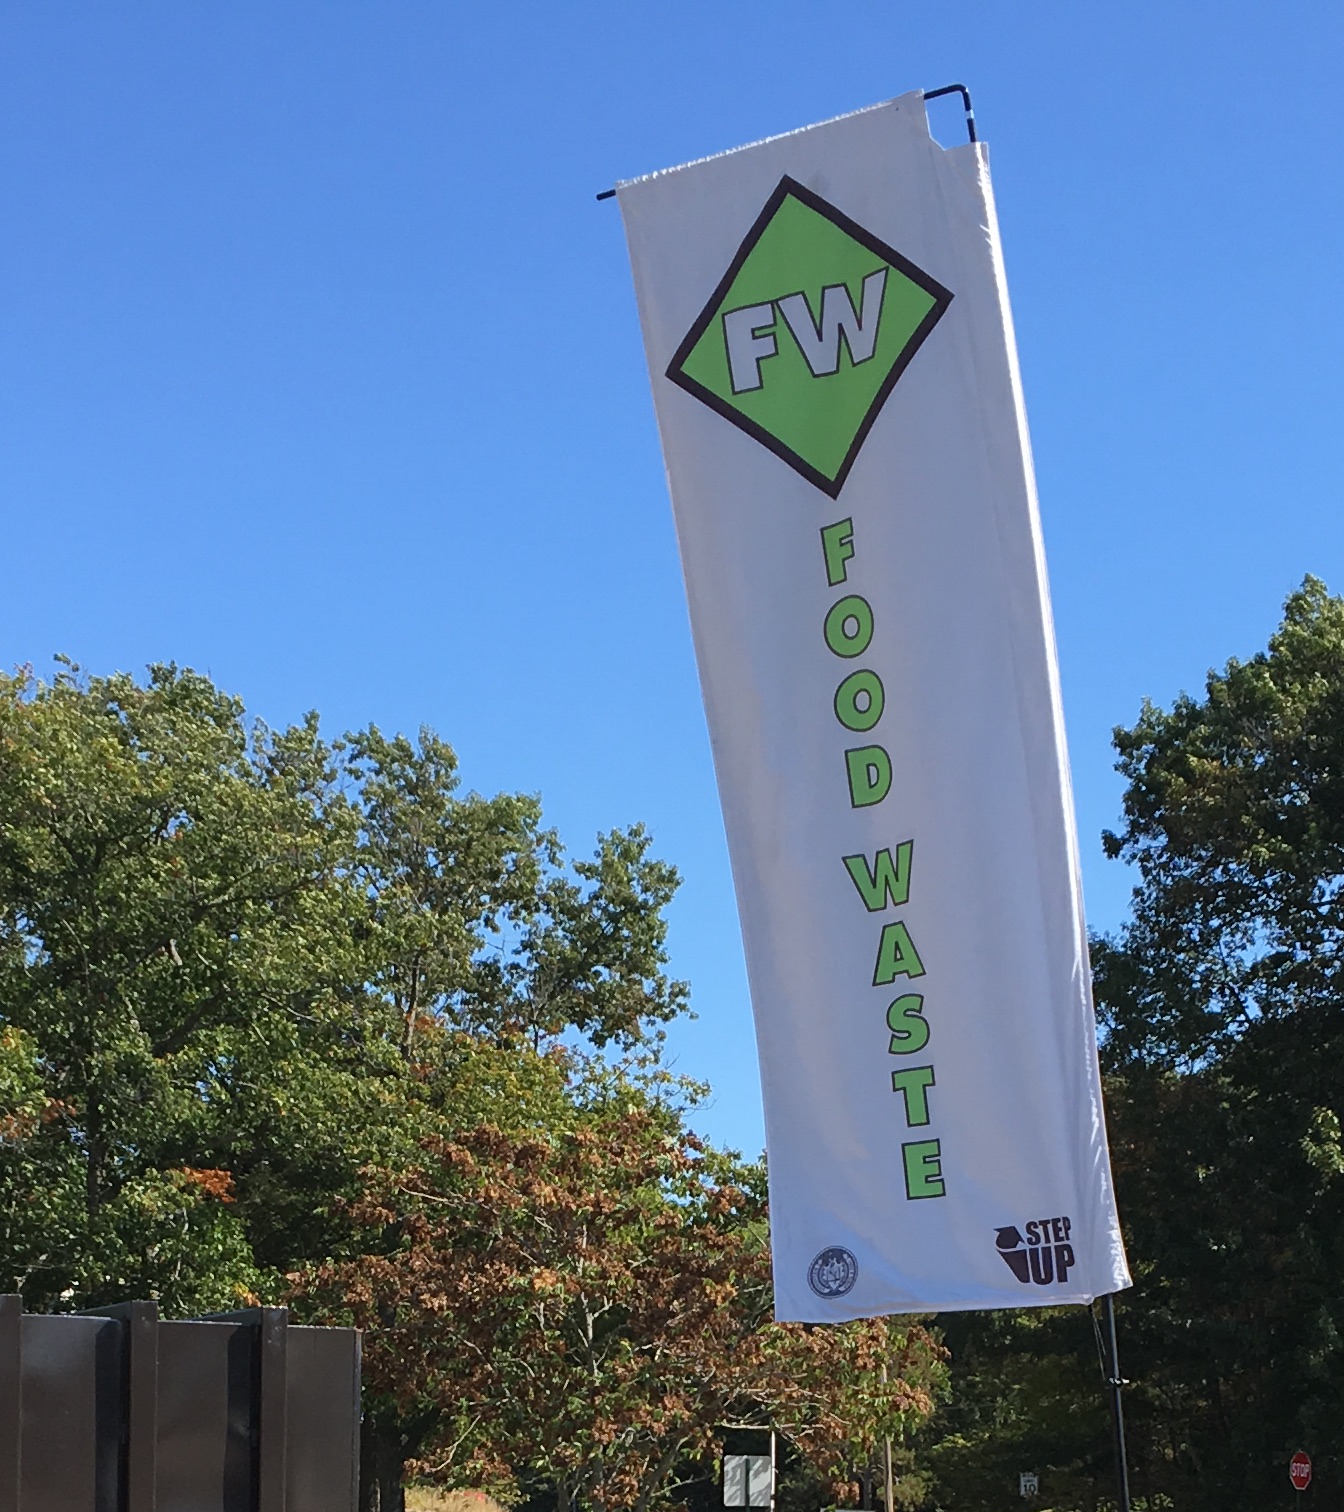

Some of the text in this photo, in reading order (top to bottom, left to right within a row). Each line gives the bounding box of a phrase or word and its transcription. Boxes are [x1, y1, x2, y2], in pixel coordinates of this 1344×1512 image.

[722, 267, 889, 395] FW
[820, 517, 946, 1200] FOOD WASTE
[1025, 1216, 1071, 1246] STEP
[1029, 1244, 1075, 1285] UP
[1291, 1462, 1309, 1477] STOP
